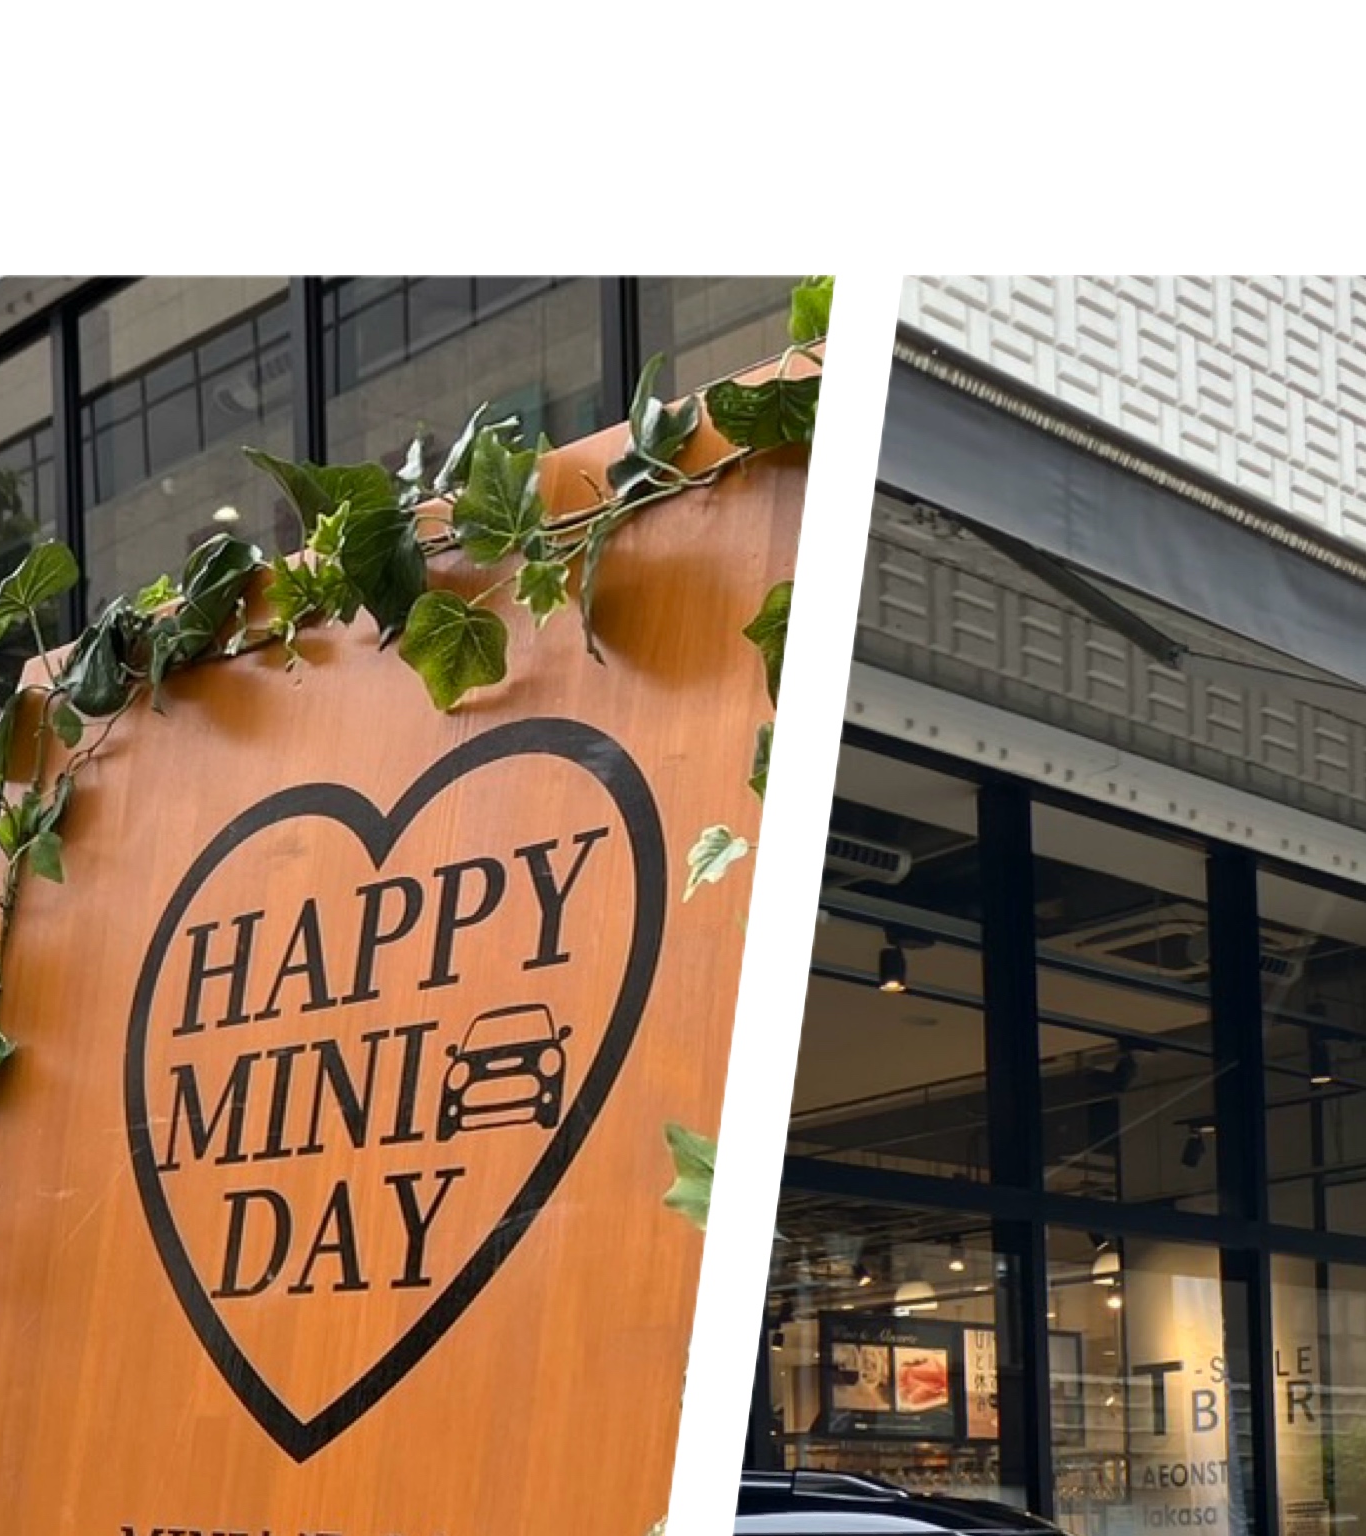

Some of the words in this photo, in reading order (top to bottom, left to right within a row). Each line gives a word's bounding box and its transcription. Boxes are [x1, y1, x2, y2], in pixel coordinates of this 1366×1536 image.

[172, 827, 610, 1038] HAPPY
[156, 1021, 439, 1172] MINI
[210, 1167, 465, 1299] DAY
